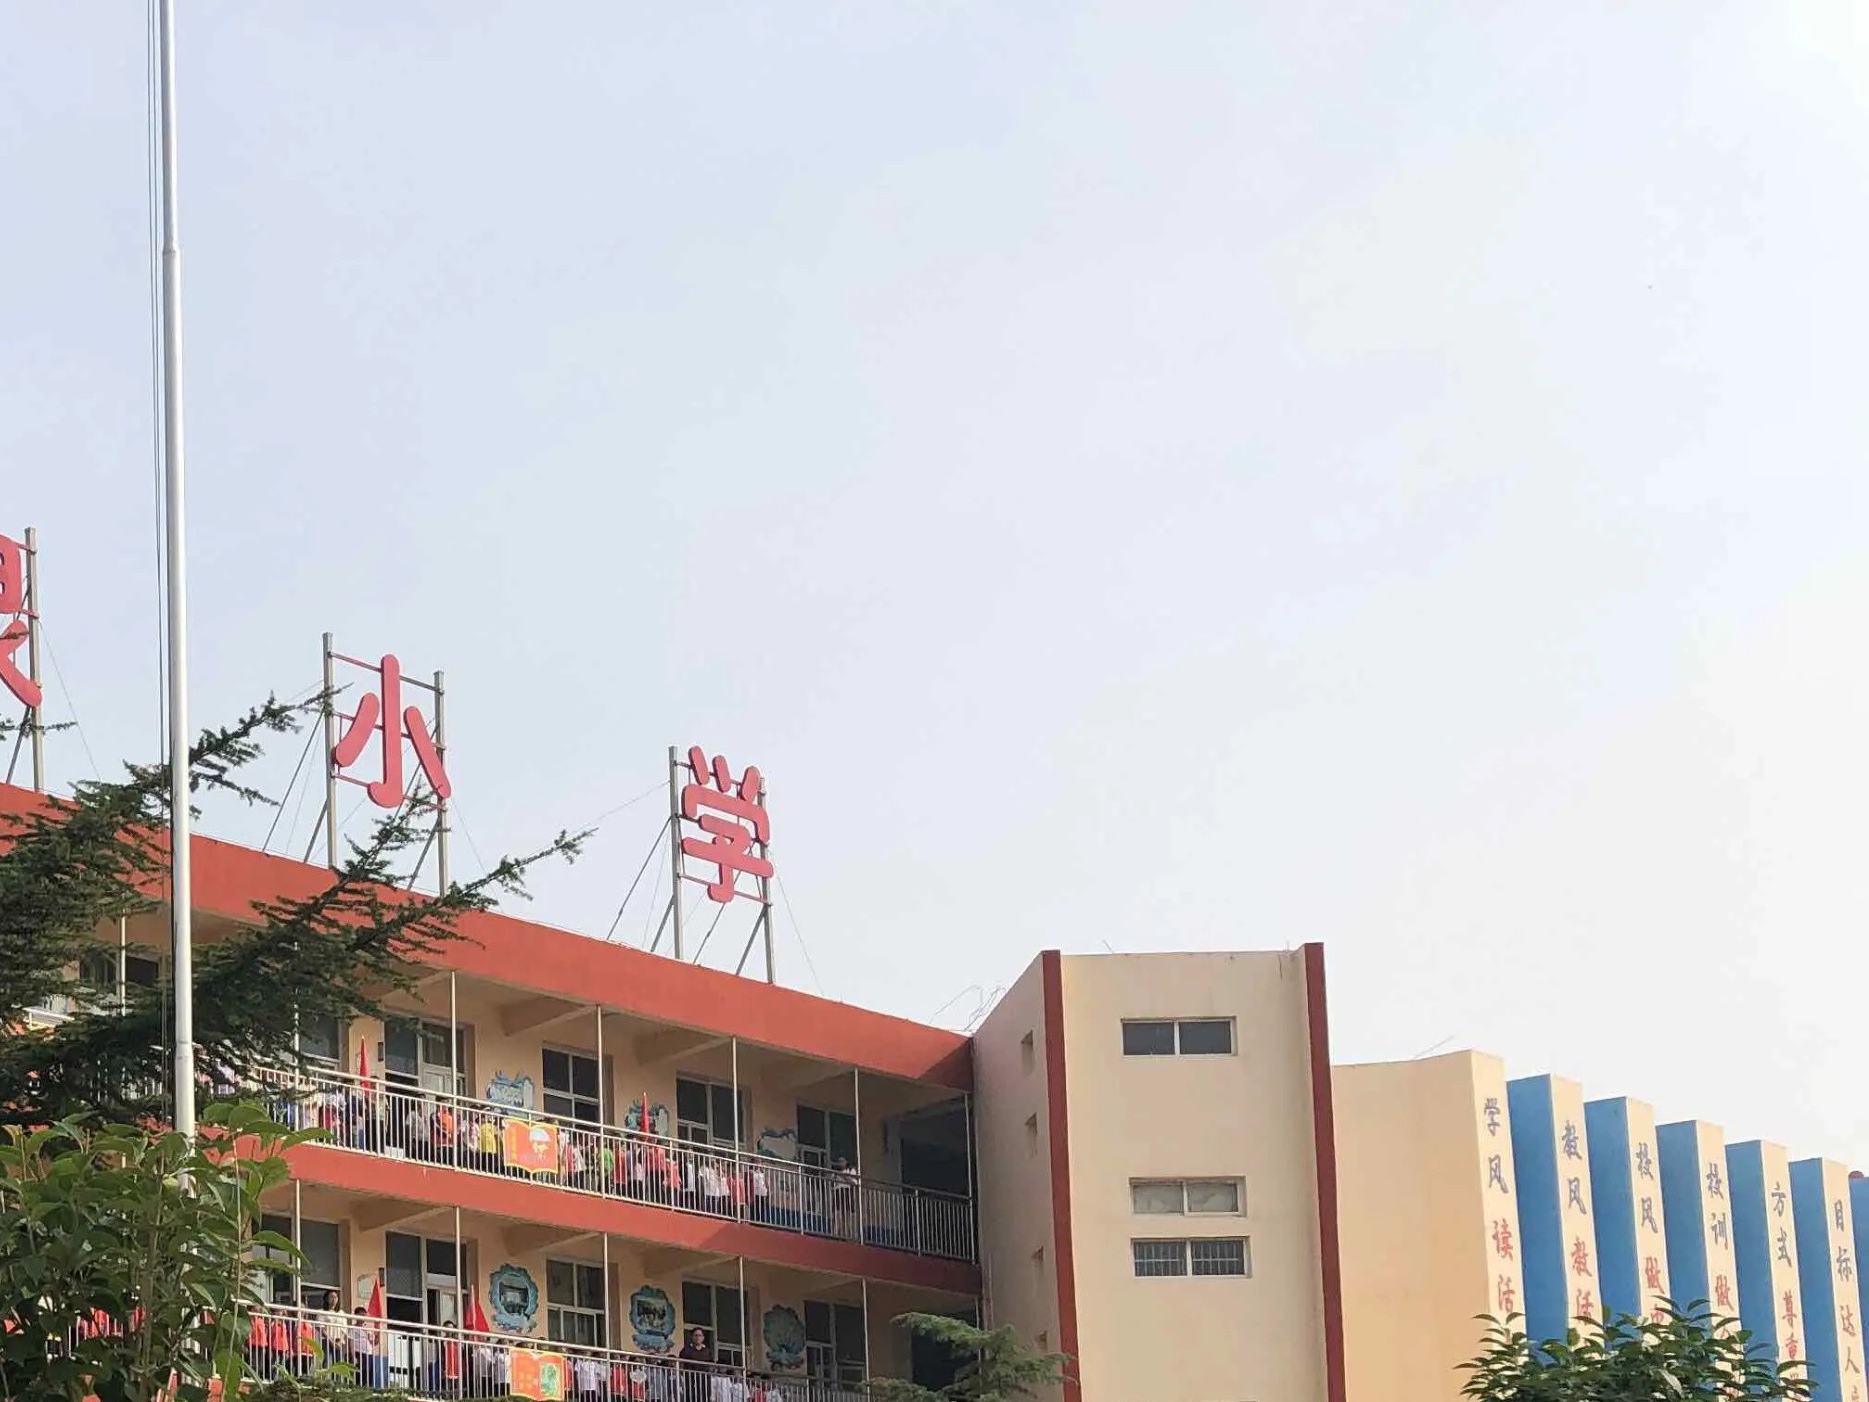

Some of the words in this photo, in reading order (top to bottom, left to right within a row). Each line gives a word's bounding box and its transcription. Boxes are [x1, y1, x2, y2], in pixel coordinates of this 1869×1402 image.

[1484, 1098, 1509, 1193] 学风
[1561, 1120, 1587, 1215] 教风
[1635, 1142, 1658, 1234] 校风
[1706, 1162, 1728, 1251] 校训
[1771, 1181, 1792, 1268] 方式
[1833, 1199, 1852, 1283] 目标
